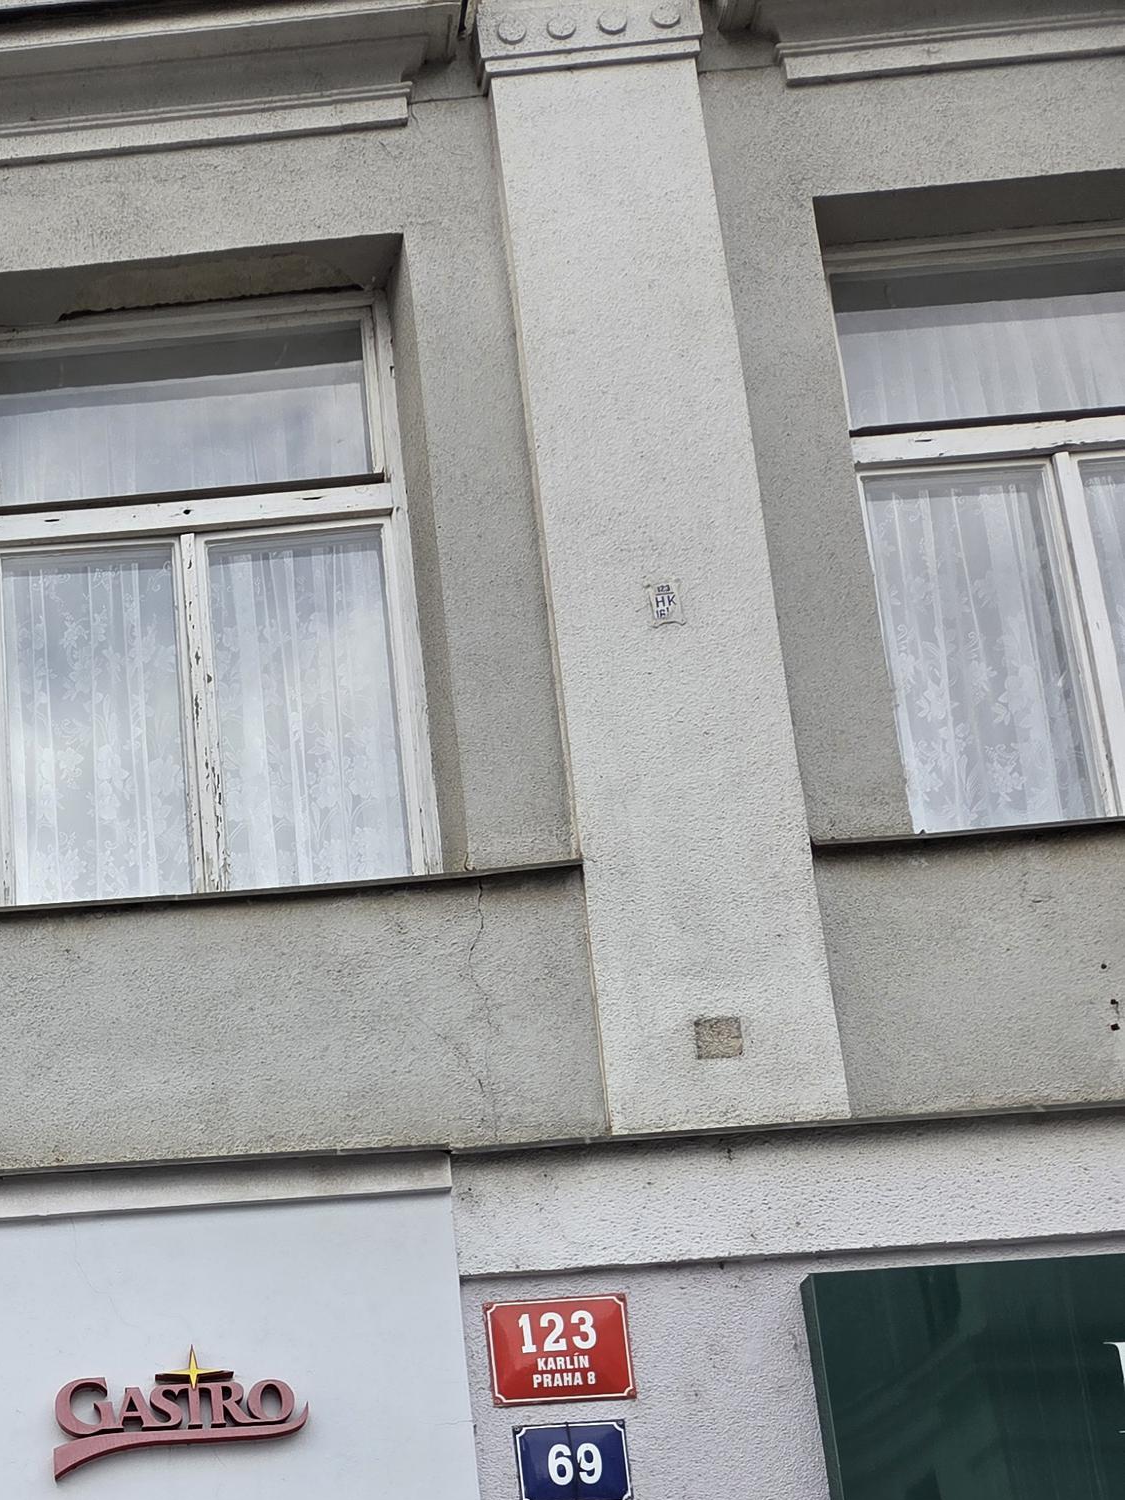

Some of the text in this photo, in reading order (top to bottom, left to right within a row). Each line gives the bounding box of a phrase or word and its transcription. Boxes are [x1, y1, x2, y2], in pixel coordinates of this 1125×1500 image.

[655, 595, 677, 608] HK
[518, 1310, 597, 1354] 123
[537, 1352, 590, 1371] KARLÍN
[533, 1371, 596, 1389] PRAHA 8
[55, 1376, 296, 1436] GASTRO
[547, 1442, 603, 1486] 69
